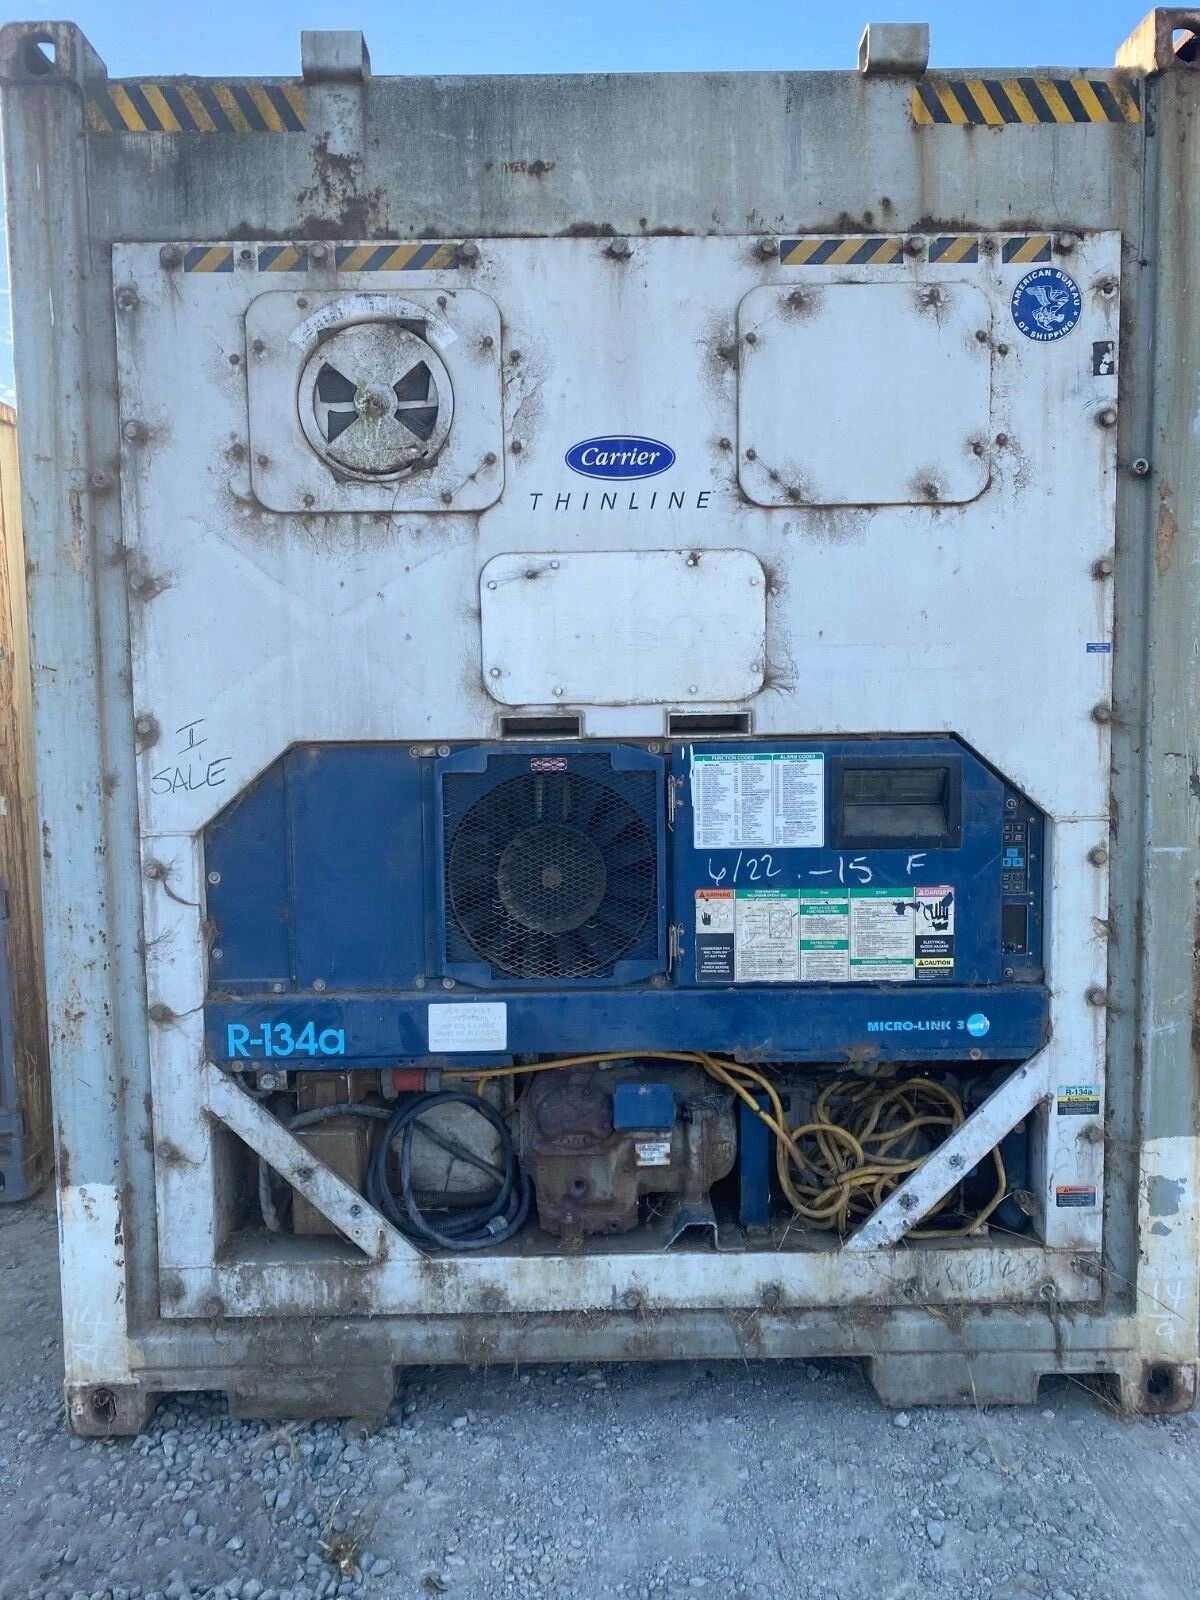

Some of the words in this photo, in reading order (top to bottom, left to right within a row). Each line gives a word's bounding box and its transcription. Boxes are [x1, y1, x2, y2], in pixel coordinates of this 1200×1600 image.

[1013, 269, 1051, 306] AMERICAN
[1056, 271, 1080, 306] BUREAU
[1018, 321, 1029, 332] OF
[1030, 320, 1074, 340] SHIPPING
[581, 447, 660, 466] Carrier
[530, 491, 711, 511] THINLINE
[151, 757, 232, 794] SALE
[906, 853, 927, 875] F
[867, 1021, 951, 1032] MICRO-LINK
[956, 1020, 965, 1030] 3
[228, 1021, 345, 1057] R-134a
[1065, 1088, 1093, 1096] R-134a
